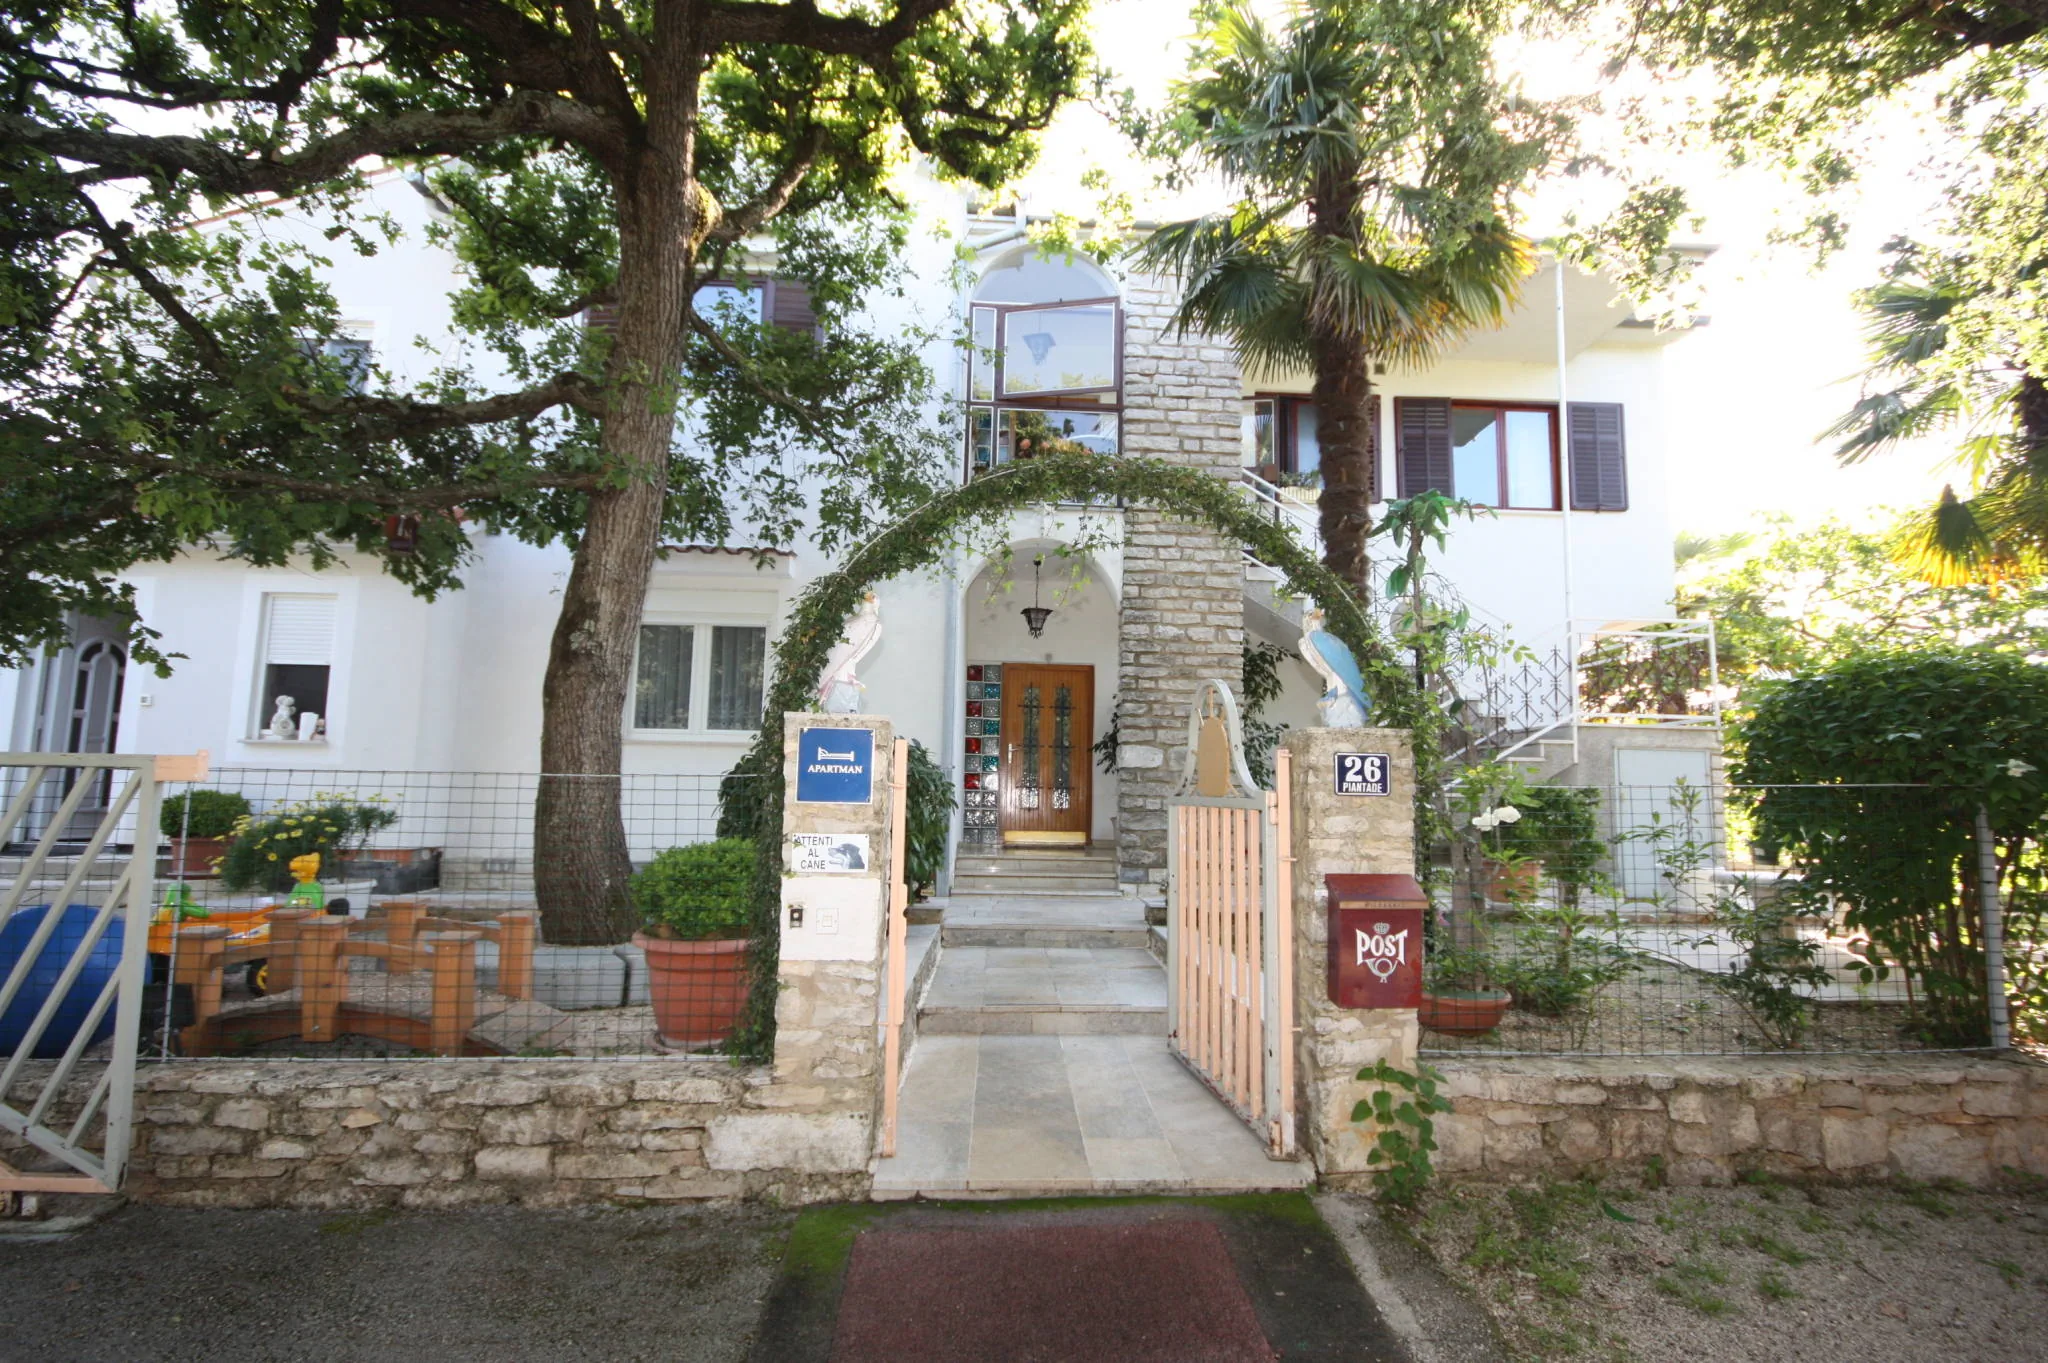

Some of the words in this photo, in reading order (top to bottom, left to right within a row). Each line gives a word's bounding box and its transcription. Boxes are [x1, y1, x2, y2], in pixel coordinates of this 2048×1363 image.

[807, 764, 863, 774] APARTMAN
[1345, 756, 1381, 782] 26
[1342, 782, 1383, 793] PIANTADE
[795, 836, 832, 846] ATTENTI
[808, 848, 819, 858] AL
[800, 859, 826, 869] CANE
[1355, 928, 1408, 966] POST
